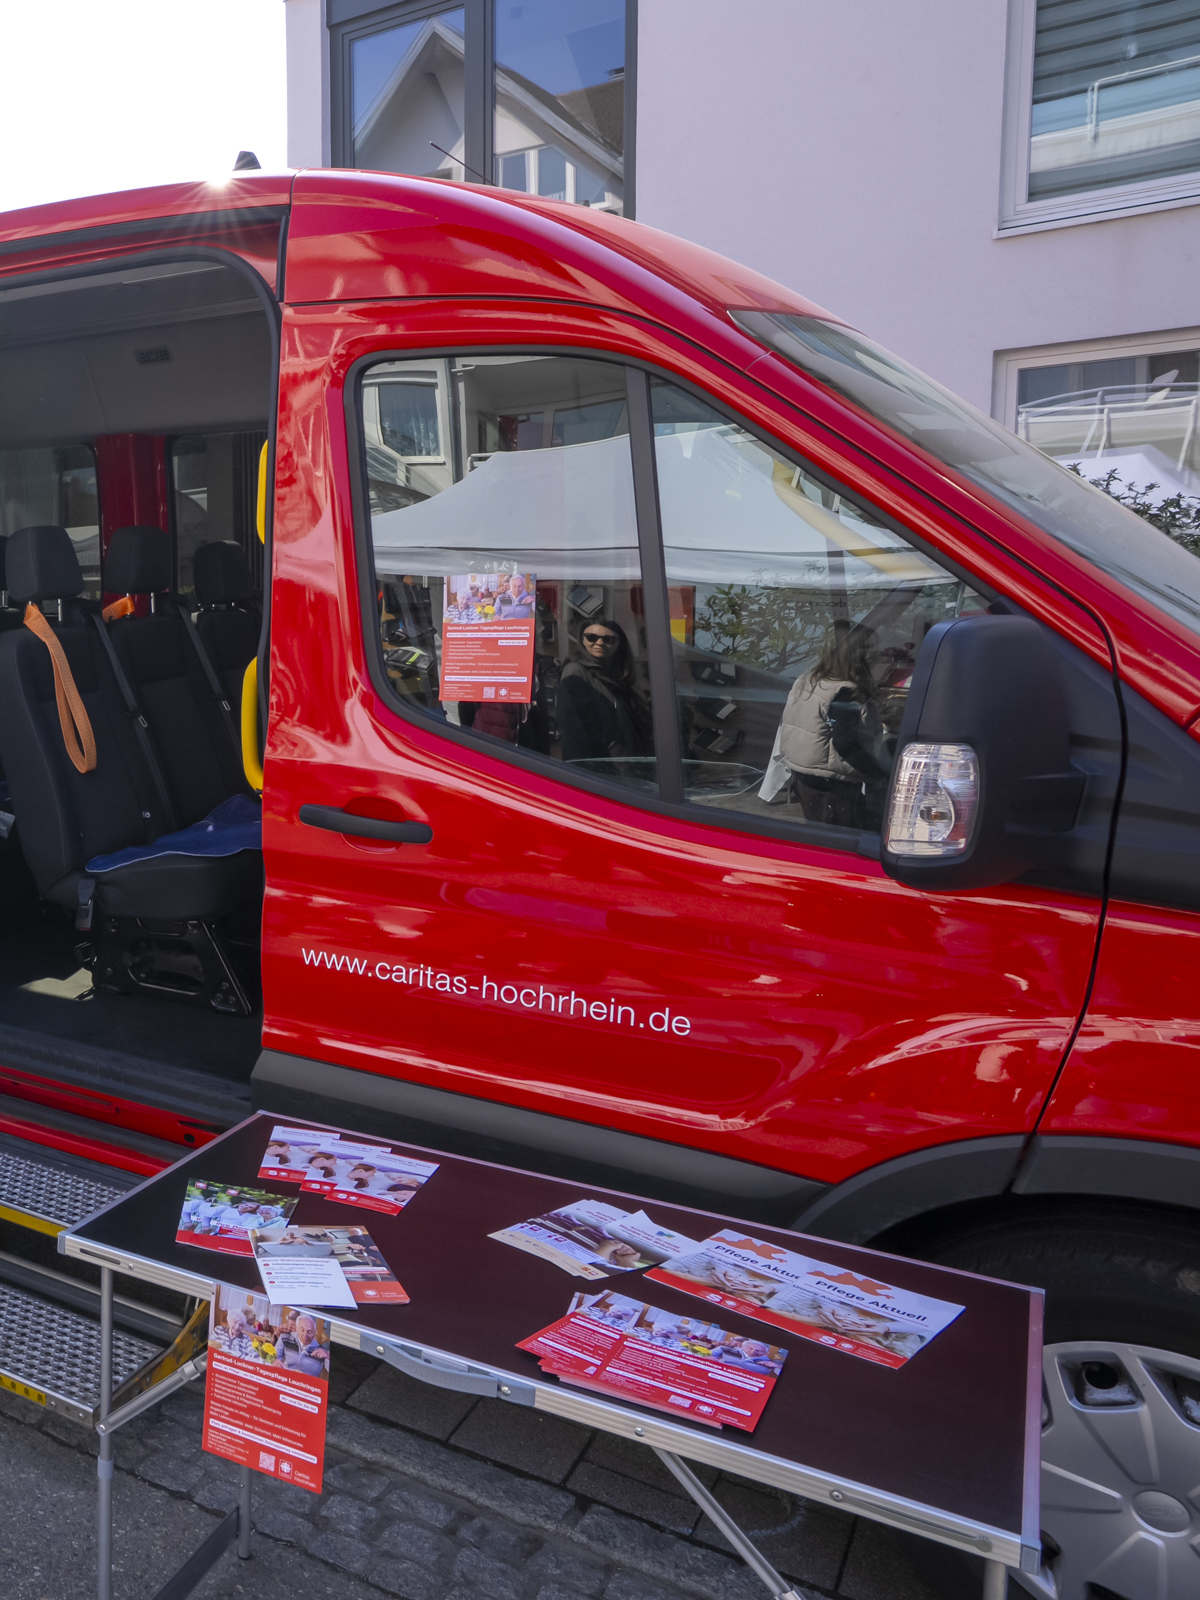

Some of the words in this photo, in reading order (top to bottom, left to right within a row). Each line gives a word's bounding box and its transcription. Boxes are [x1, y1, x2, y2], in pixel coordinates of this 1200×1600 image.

[301, 947, 692, 1037] www.caritas-hochrhein.de
[714, 1244, 758, 1266] Pflege
[761, 1264, 800, 1280] Aktue
[816, 1280, 865, 1302] Pflege
[868, 1300, 928, 1322] Aktuell
[213, 1352, 287, 1382] Gertrud-Luckner-Tagespflege
[288, 1378, 321, 1394] Lauchringen
[294, 1469, 309, 1480] Caritas
[294, 1475, 316, 1488] Hochrhein
